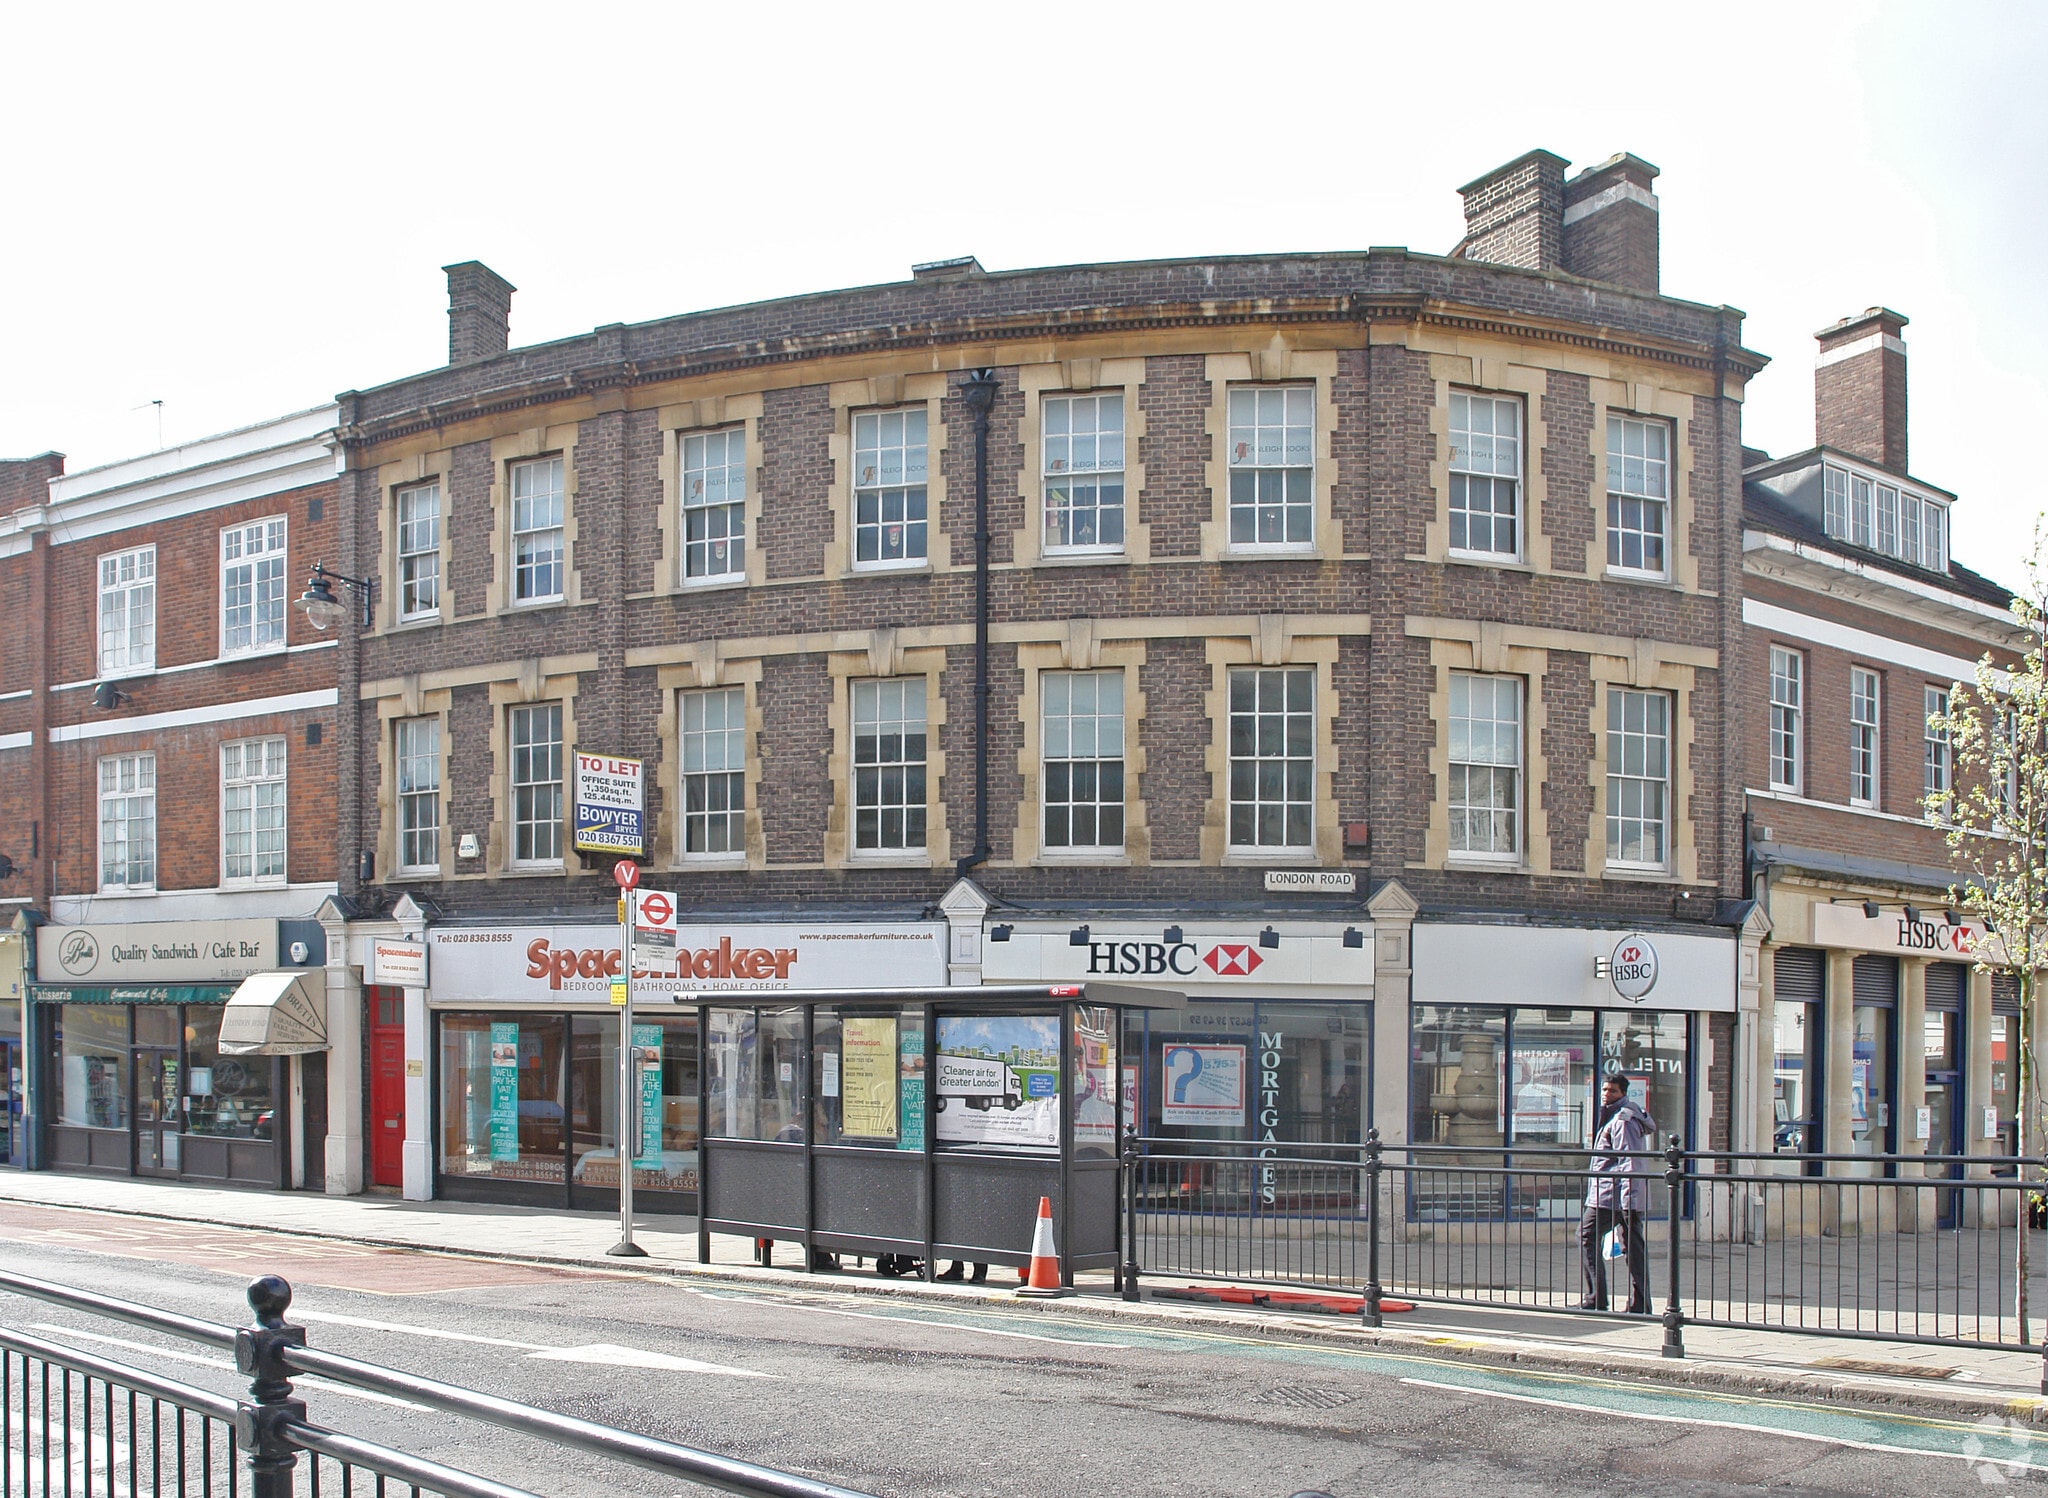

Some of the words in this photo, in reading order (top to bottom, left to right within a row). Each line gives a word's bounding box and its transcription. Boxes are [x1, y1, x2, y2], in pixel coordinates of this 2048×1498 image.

[579, 757, 602, 772] TO
[608, 760, 640, 776] LET
[582, 775, 610, 786] OFFICE
[613, 778, 636, 789] SUITE
[580, 806, 637, 826] BOWYER
[615, 825, 638, 835] BRYCE
[578, 831, 596, 842] 020
[598, 834, 620, 845] 8367
[622, 836, 640, 847] 5511
[621, 865, 635, 883] V
[1269, 873, 1315, 884] LONDON
[1320, 874, 1351, 885] ROAD
[437, 934, 452, 943] Tel:
[453, 934, 468, 943] 020
[470, 934, 490, 943] 8363
[492, 934, 513, 942] 8555
[799, 932, 934, 942] www.spacemakerfurniture.co.uk
[1897, 918, 1949, 951] HSBC
[112, 944, 147, 963] Quality
[152, 943, 198, 960] Sandwich
[212, 941, 237, 959] Cafe
[377, 946, 422, 958] Spacemaker
[1086, 942, 1198, 975] HSBC
[526, 936, 797, 990] Spacaker
[1615, 963, 1651, 981] HSBC
[31, 987, 72, 1000] Patisserie
[563, 982, 611, 991] BEDROOM
[634, 982, 697, 991] BATHROOMS
[713, 982, 745, 991] HOME
[750, 982, 788, 990] OFFICE
[287, 992, 318, 1028] BRETTS
[976, 1067, 984, 1076] air
[986, 1068, 996, 1077] for
[940, 1076, 971, 1087] Greater
[516, 1170, 533, 1178] 8363
[536, 1171, 553, 1180] 8555
[650, 1178, 671, 1187] 8363
[673, 1179, 694, 1189] 8555
